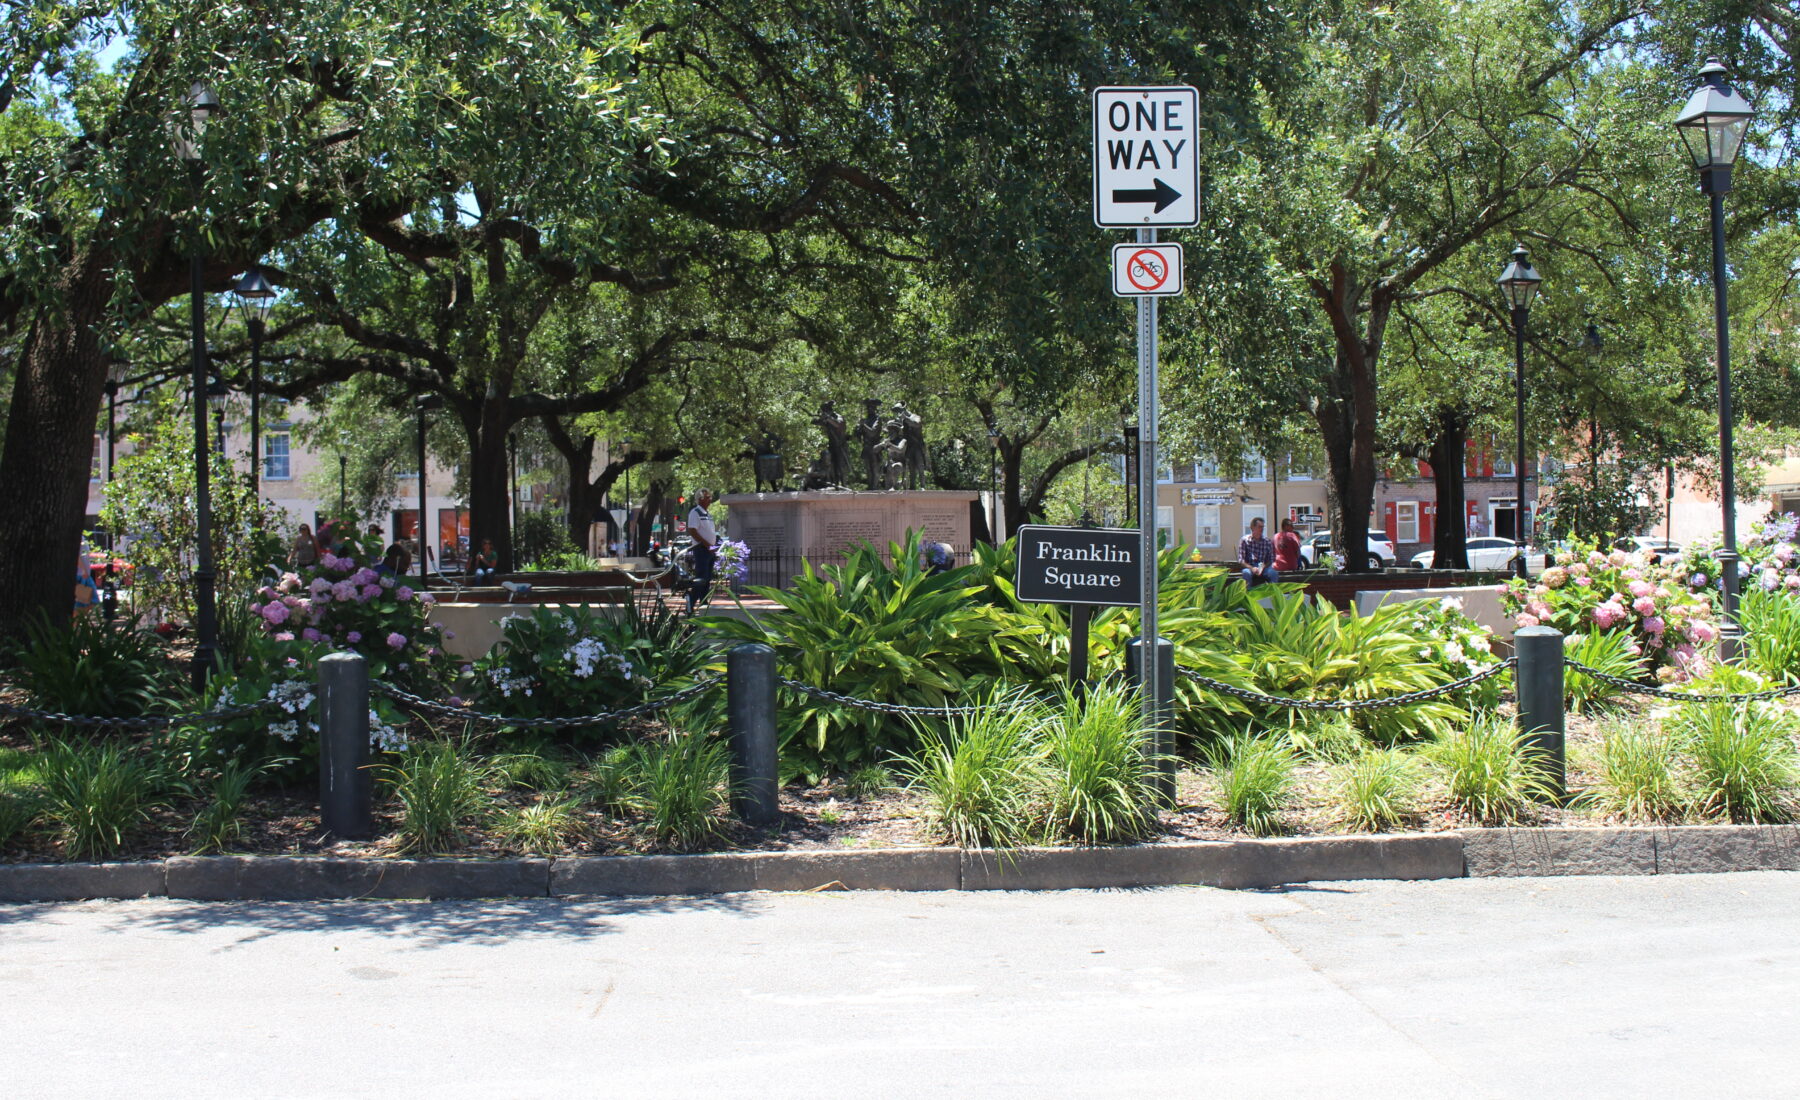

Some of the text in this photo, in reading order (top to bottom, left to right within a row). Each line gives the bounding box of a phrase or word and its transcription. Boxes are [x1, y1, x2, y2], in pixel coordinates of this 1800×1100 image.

[1108, 100, 1184, 132] ONE
[1107, 138, 1187, 170] WAY
[1036, 541, 1132, 563] Franklin
[1044, 566, 1121, 589] Square
